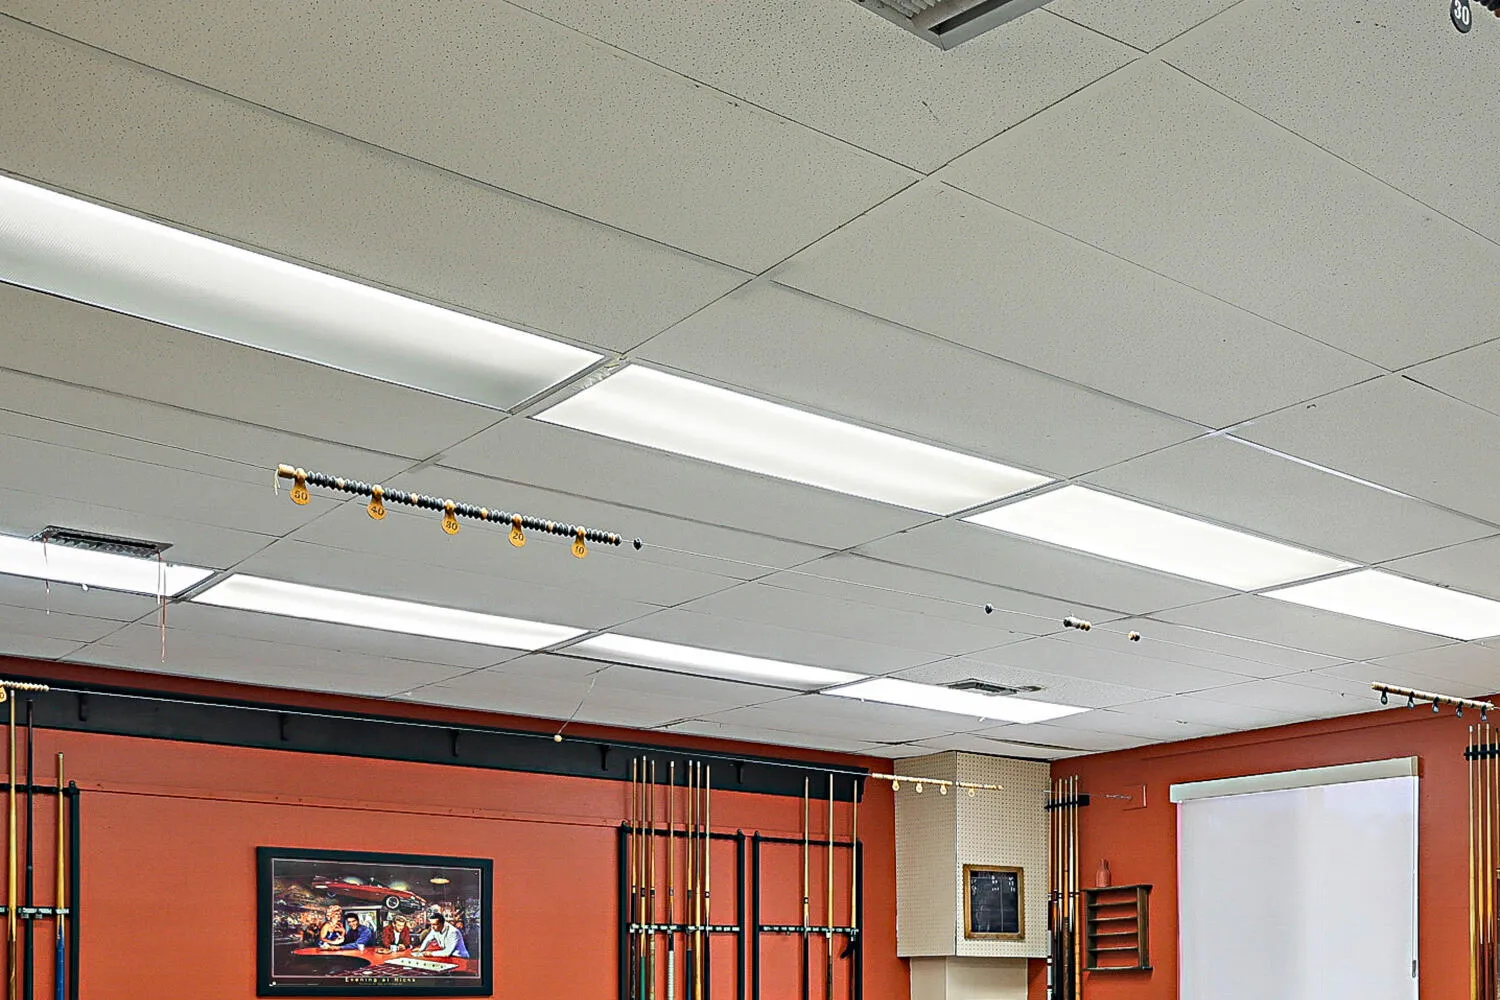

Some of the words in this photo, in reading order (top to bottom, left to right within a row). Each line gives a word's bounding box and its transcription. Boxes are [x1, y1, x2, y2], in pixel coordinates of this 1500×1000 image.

[1454, 0, 1470, 26] 30
[294, 490, 308, 501] 50
[370, 506, 384, 516] 40
[446, 521, 458, 531] 30
[512, 533, 524, 542] 20
[575, 546, 585, 555] 10
